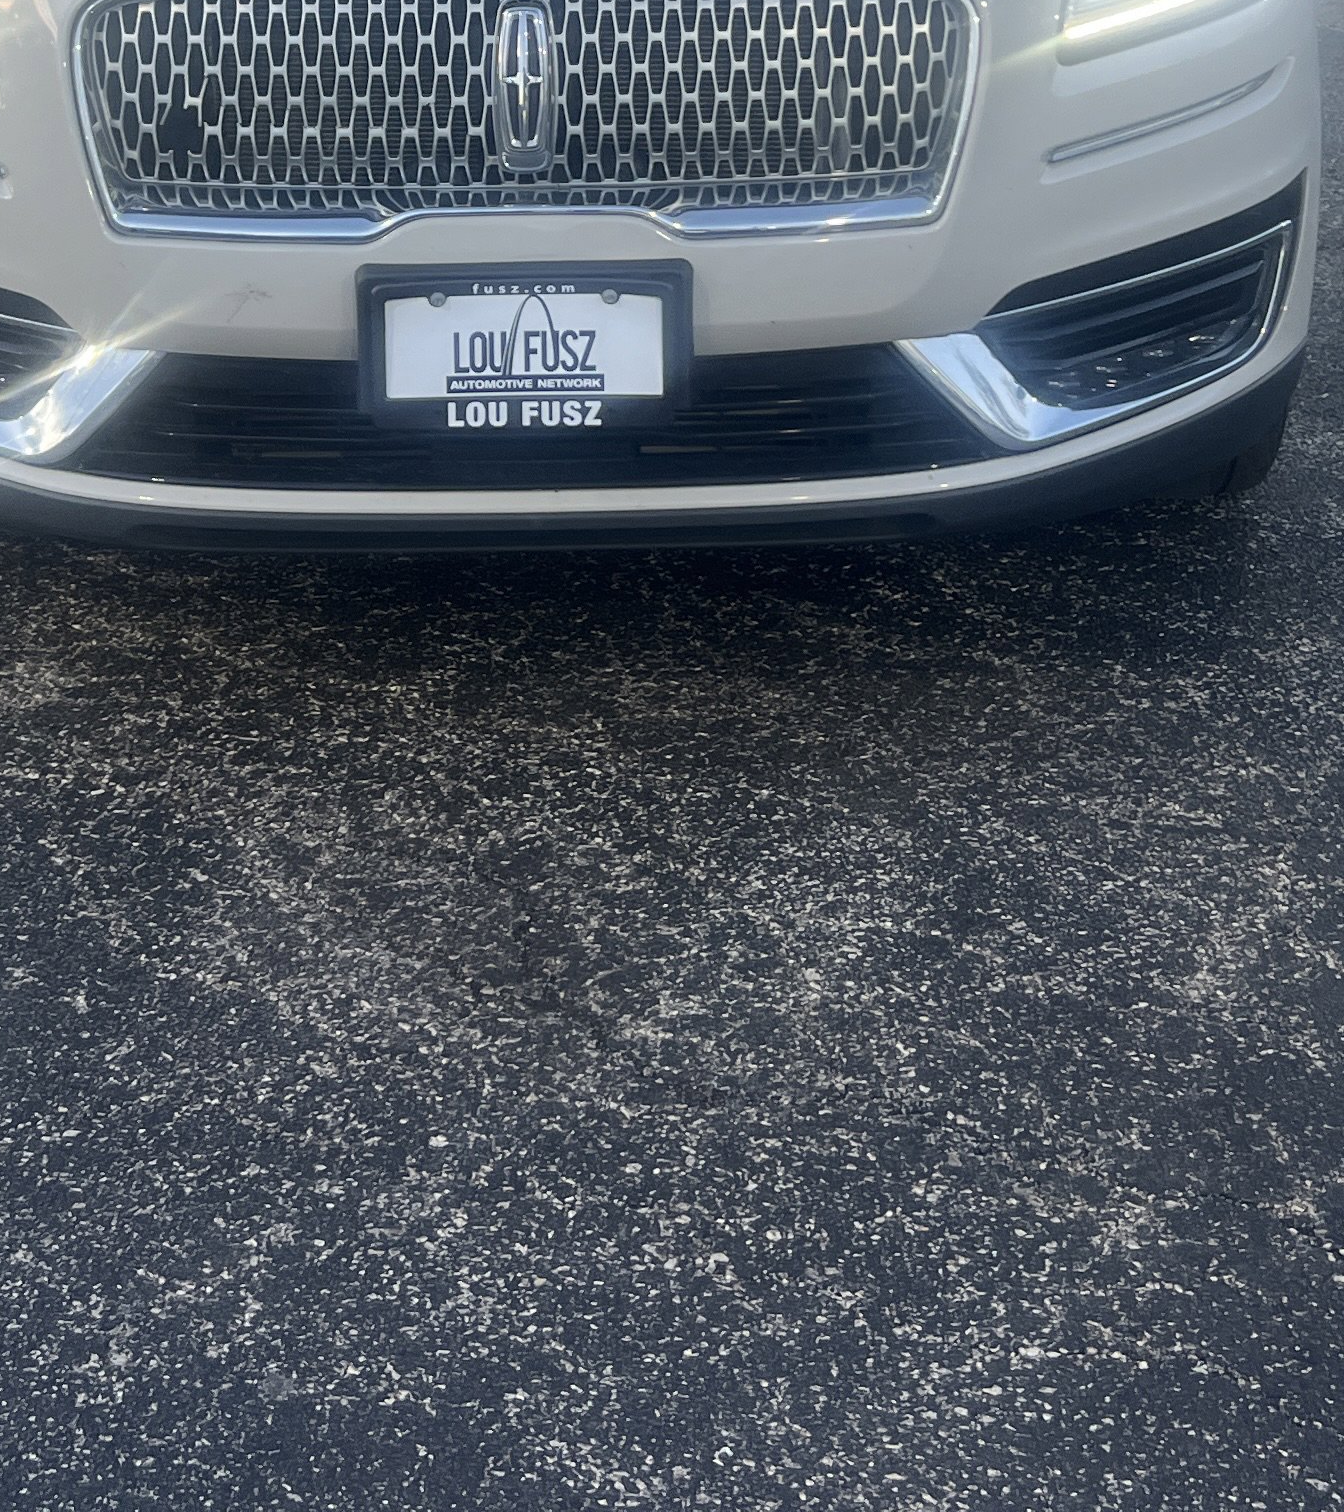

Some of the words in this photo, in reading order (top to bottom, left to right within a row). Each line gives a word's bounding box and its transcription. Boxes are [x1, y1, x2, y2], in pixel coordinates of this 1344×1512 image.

[472, 283, 575, 294] fusz.com
[454, 331, 507, 374] LOU
[523, 330, 597, 372] FUSZ
[450, 378, 534, 390] AUTOMOTIVE
[537, 378, 602, 389] NETWORK
[447, 401, 508, 428] LOU
[521, 400, 603, 427] FUSZ
